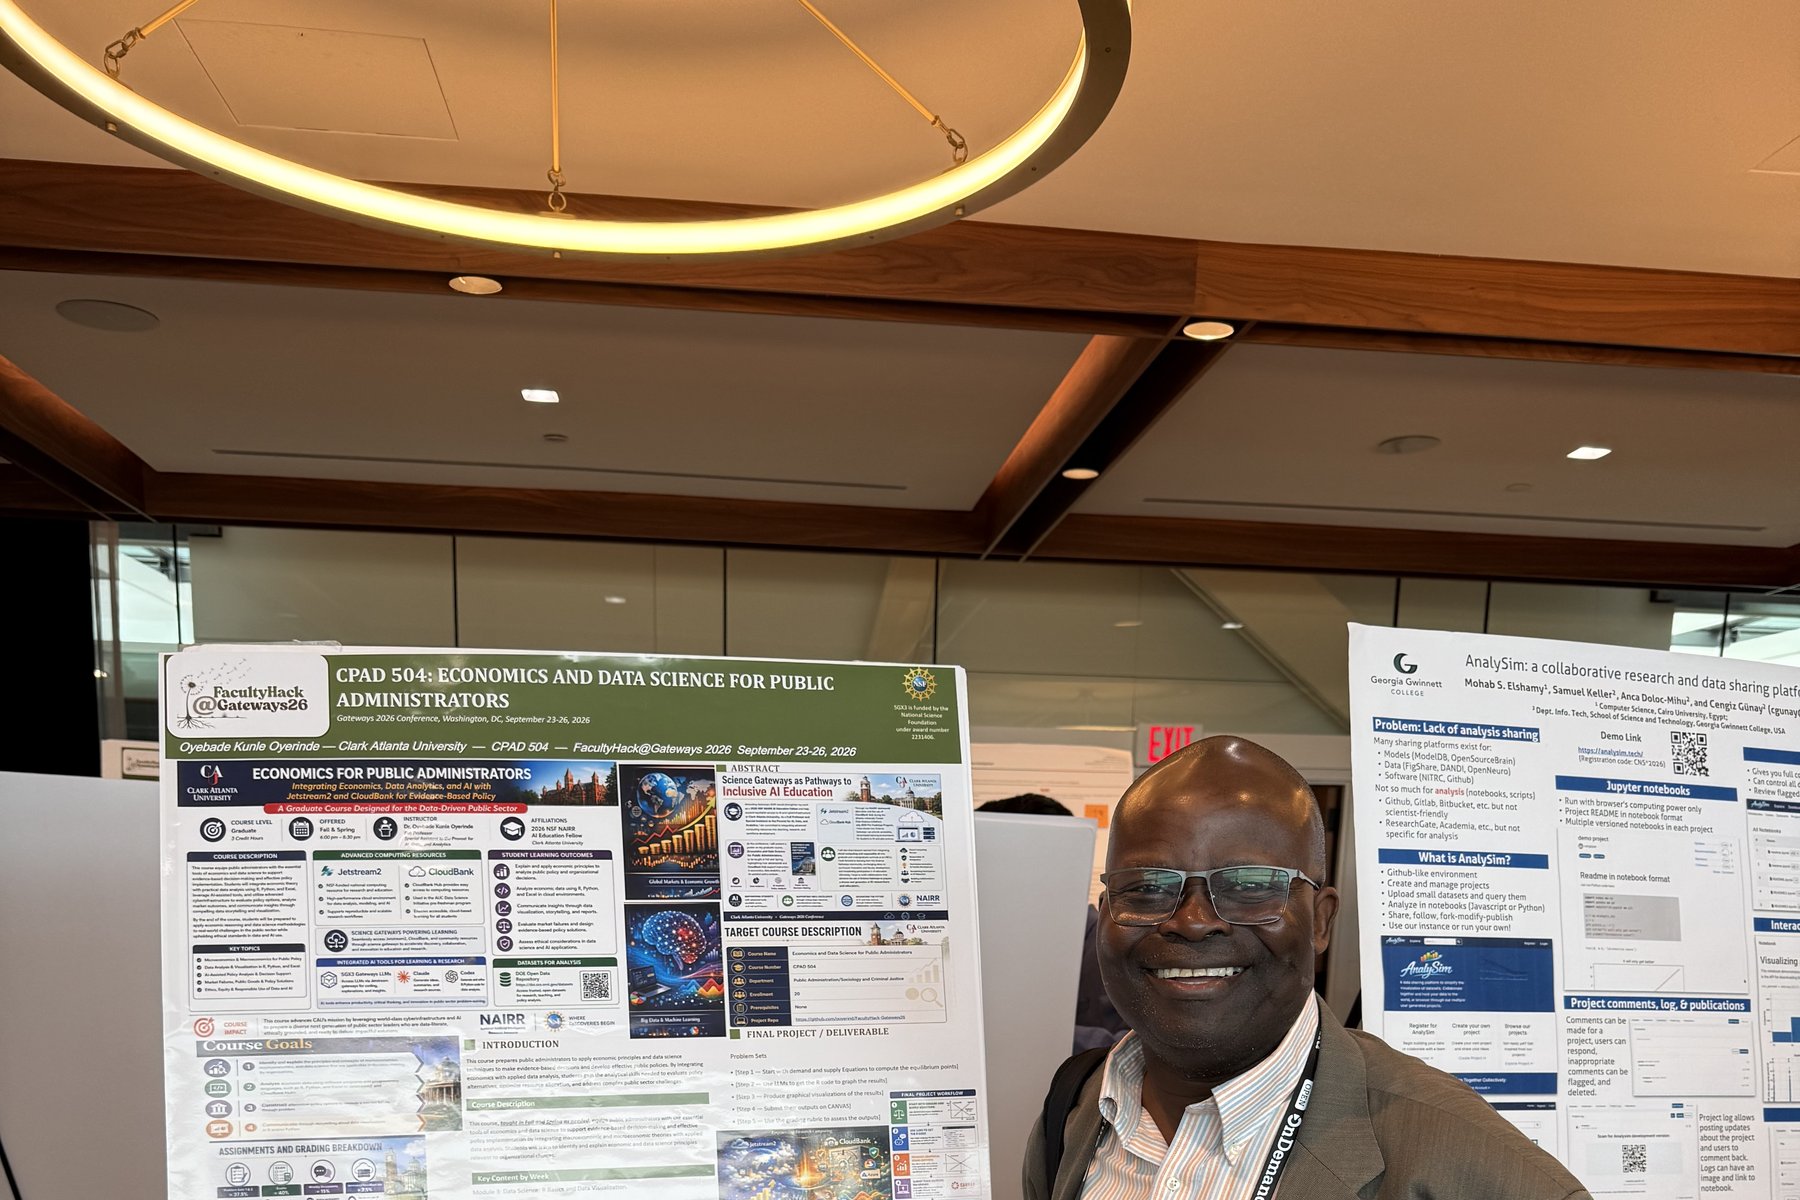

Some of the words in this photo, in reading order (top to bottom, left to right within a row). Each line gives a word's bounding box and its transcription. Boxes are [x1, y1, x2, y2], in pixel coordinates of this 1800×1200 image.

[336, 667, 385, 682] CPAD
[392, 668, 432, 682] 504:
[438, 669, 547, 685] ECONOMICS
[553, 670, 592, 684] AND
[599, 671, 644, 685] DATA
[650, 672, 724, 687] SCIENCE
[730, 673, 764, 688] FOR
[770, 674, 833, 690] PUBLIC
[1466, 654, 1527, 674] AnalySim:
[1531, 662, 1537, 672] a
[1542, 661, 1620, 679] collaborative
[1625, 668, 1674, 684] research
[1678, 673, 1698, 687] and
[1702, 675, 1725, 689] data
[1729, 678, 1769, 696] sharing
[1370, 676, 1402, 686] Georgia
[1405, 677, 1441, 687] Gwinnett
[213, 686, 303, 701] FacultyHack
[1390, 688, 1423, 696] COLLEGE
[193, 696, 307, 714] @Gateways26
[336, 692, 508, 707] ADMINISTRATORS
[1375, 719, 1420, 735] Problem:
[1423, 722, 1445, 736] Lack
[1447, 724, 1458, 737] of
[1460, 724, 1500, 739] analysis
[1502, 727, 1538, 742] sharing
[1600, 731, 1623, 740] Demo
[1625, 733, 1642, 741] Link
[180, 742, 230, 754] Oyebade
[233, 742, 266, 751] Kunle
[269, 742, 319, 753] Oyerinde
[412, 743, 466, 753] University
[573, 744, 702, 756] FacultyHack@Gateways
[704, 745, 731, 754] 2026
[737, 745, 793, 756] September
[795, 746, 826, 756] 23-26,
[830, 746, 856, 756] 2026
[1374, 738, 1392, 747] Many
[1395, 738, 1423, 749] sharing
[1423, 740, 1458, 751] platforms
[1460, 742, 1477, 750] exist
[253, 767, 333, 779] ECONOMICS
[337, 767, 362, 778] FOR
[366, 767, 413, 778] PUBLIC
[416, 768, 531, 779] ADMINISTRATORS
[731, 764, 779, 772] ABSTRACT
[722, 775, 752, 787] Science
[754, 776, 792, 787] Gateways
[805, 776, 841, 787] Pathways
[723, 786, 766, 796] Inclusive
[770, 786, 779, 796] AI
[783, 787, 832, 796] Education
[1606, 780, 1642, 796] Jupyter
[1642, 781, 1690, 797] notebooks
[1418, 851, 1445, 862] What
[1448, 852, 1456, 863] is
[1458, 853, 1510, 867] AnalySim?
[428, 868, 474, 877] CloudBank
[1387, 868, 1428, 878] Github-like
[1429, 870, 1477, 879] environment
[1429, 880, 1458, 890] manage
[1458, 881, 1489, 890] projects
[724, 927, 758, 938] TARGET
[762, 926, 798, 937] COURSE
[799, 926, 861, 937] DESCRIPTION
[1400, 961, 1452, 979] AnalySim
[1570, 997, 1606, 1010] Project
[1606, 999, 1658, 1011] comments,
[1660, 999, 1677, 1011] log,
[1680, 999, 1687, 1011] &
[1689, 999, 1744, 1012] publications
[480, 1014, 525, 1026] NAIRR
[1566, 1016, 1602, 1025] Comments
[747, 1030, 774, 1038] FINAL
[776, 1029, 816, 1038] PROJECT
[819, 1029, 823, 1037] /
[826, 1027, 888, 1037] DELIVERABLE
[203, 1039, 262, 1050] Course
[266, 1038, 312, 1049] Goals
[483, 1040, 558, 1048] INTRODUCTION
[1297, 1082, 1312, 1108] OPEN
